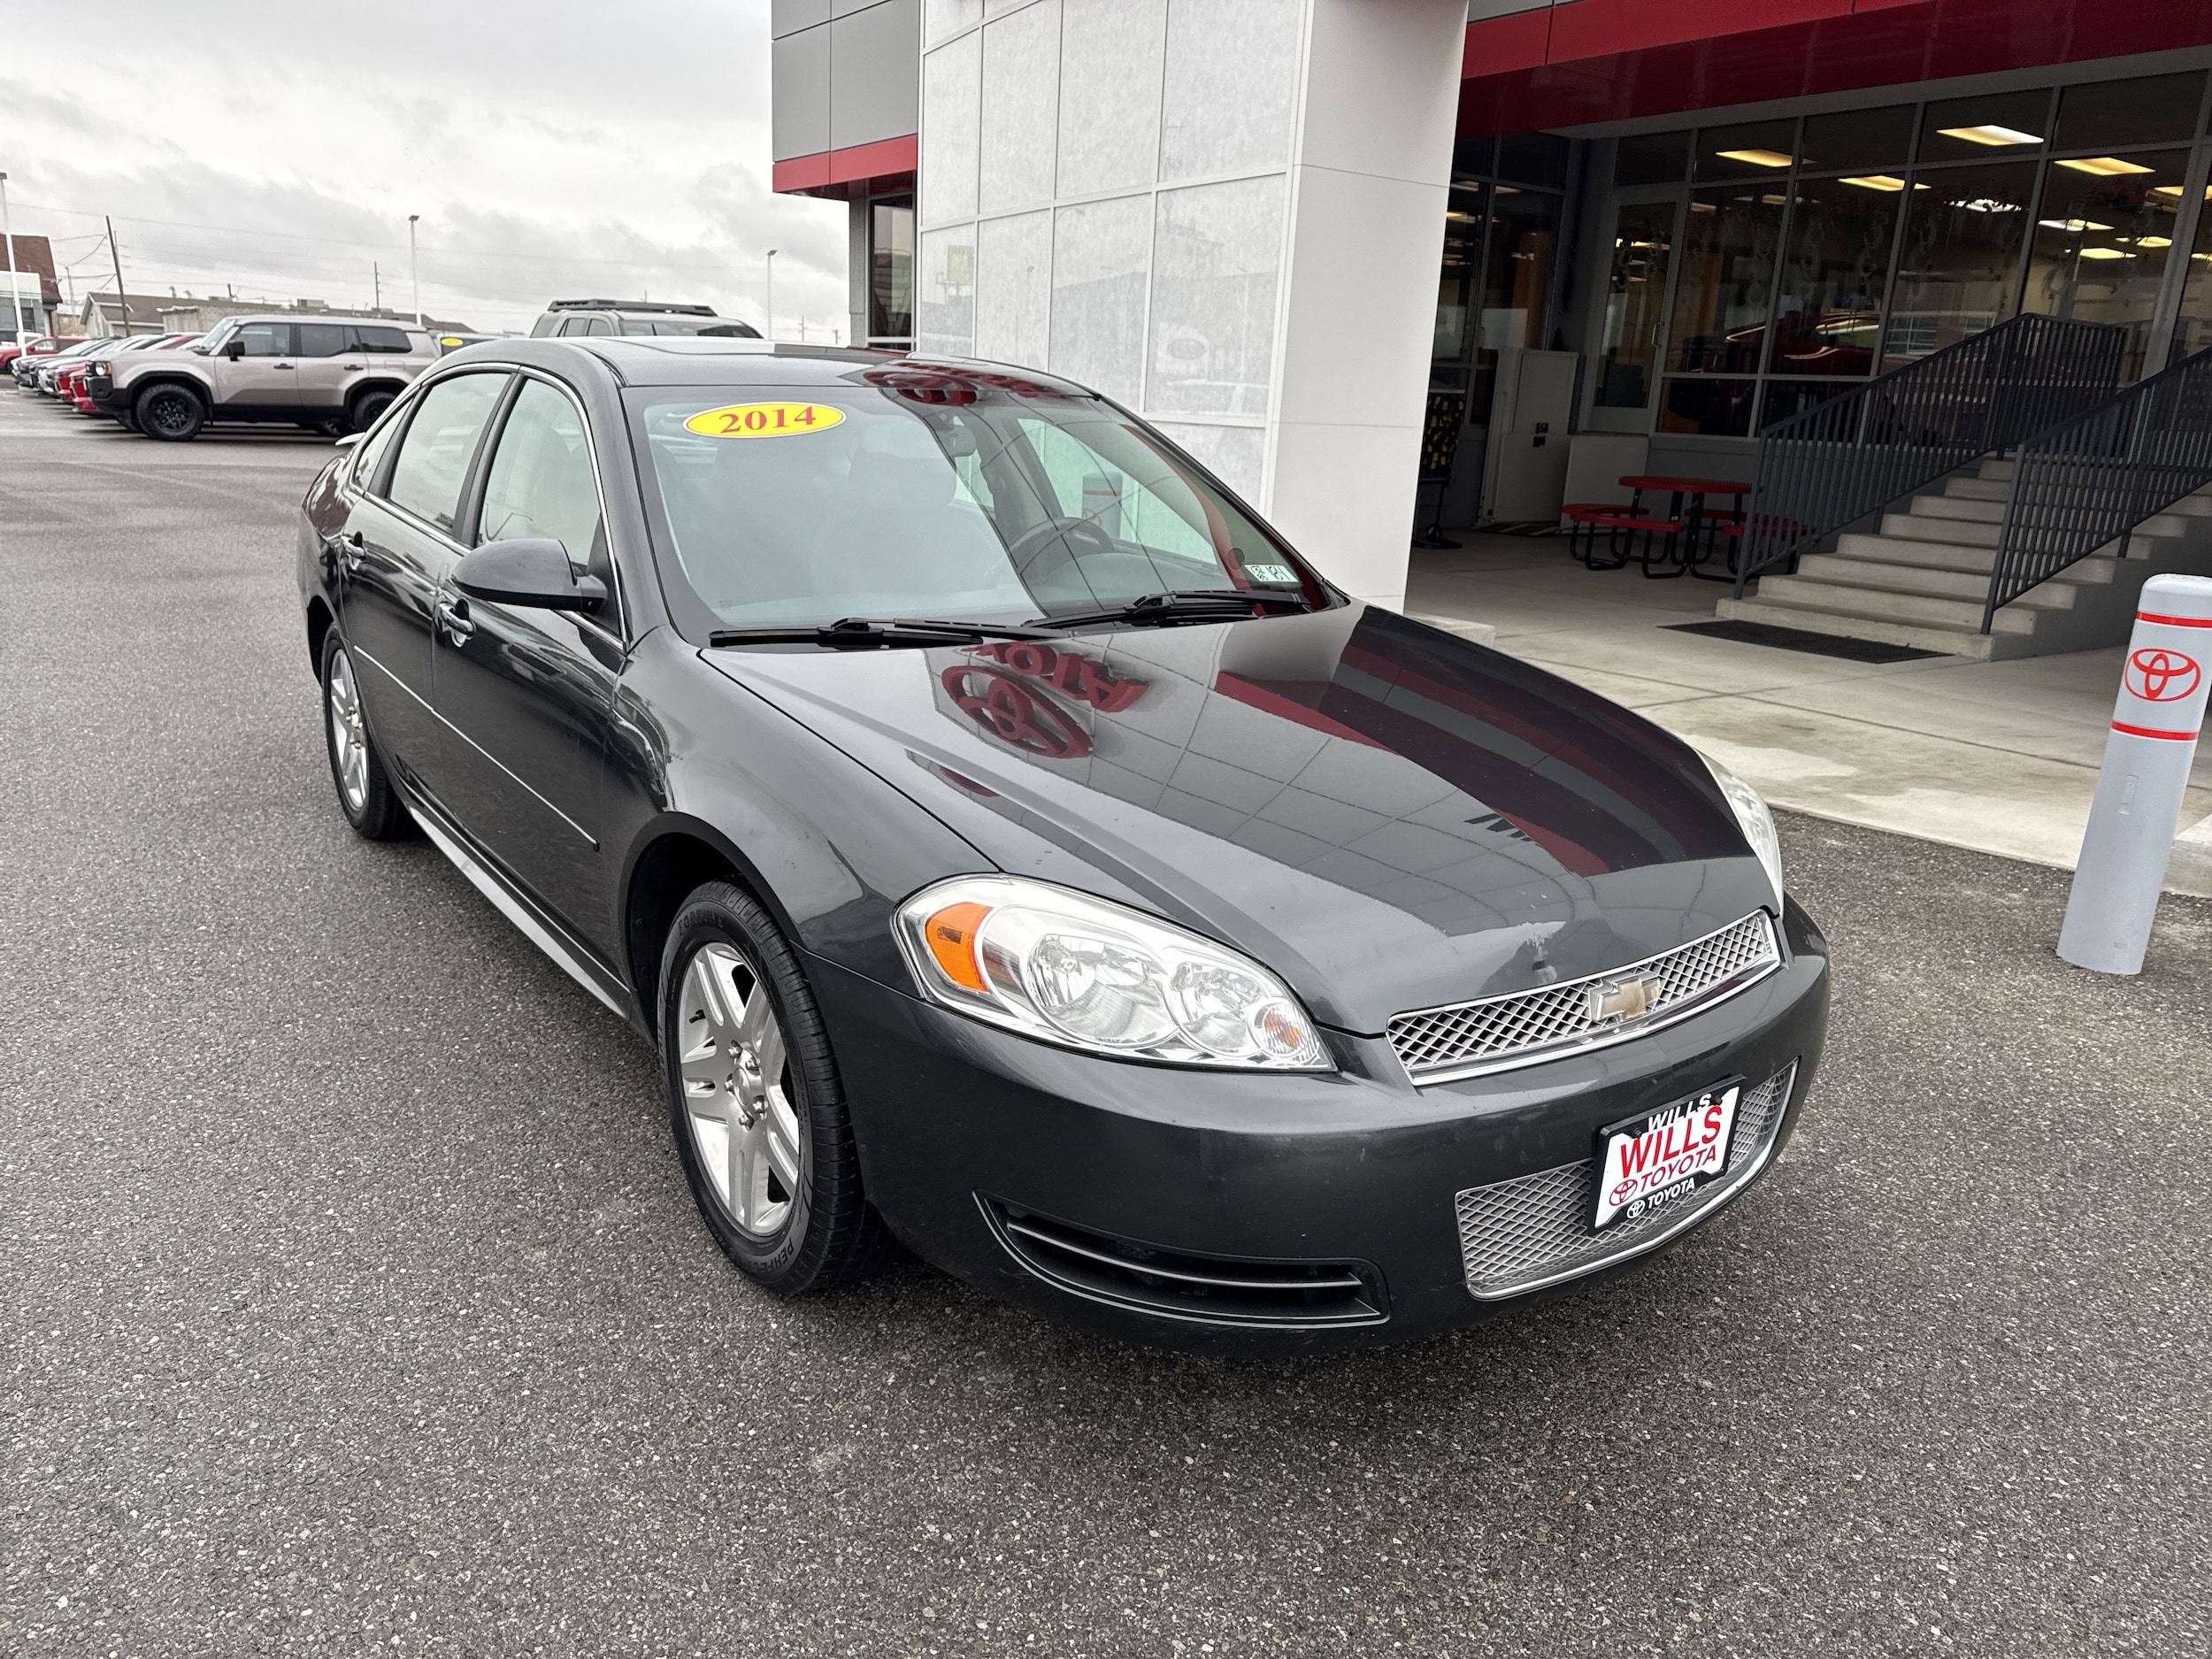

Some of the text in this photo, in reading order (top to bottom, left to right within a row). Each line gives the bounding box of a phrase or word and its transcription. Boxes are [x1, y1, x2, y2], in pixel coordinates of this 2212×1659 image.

[719, 406, 816, 434] 2014
[1648, 1093, 1711, 1132] WILLS
[1620, 1105, 1723, 1179] WILLS
[1640, 1144, 1717, 1193] TOYOTA
[1648, 1178, 1695, 1209] TOYOTA
